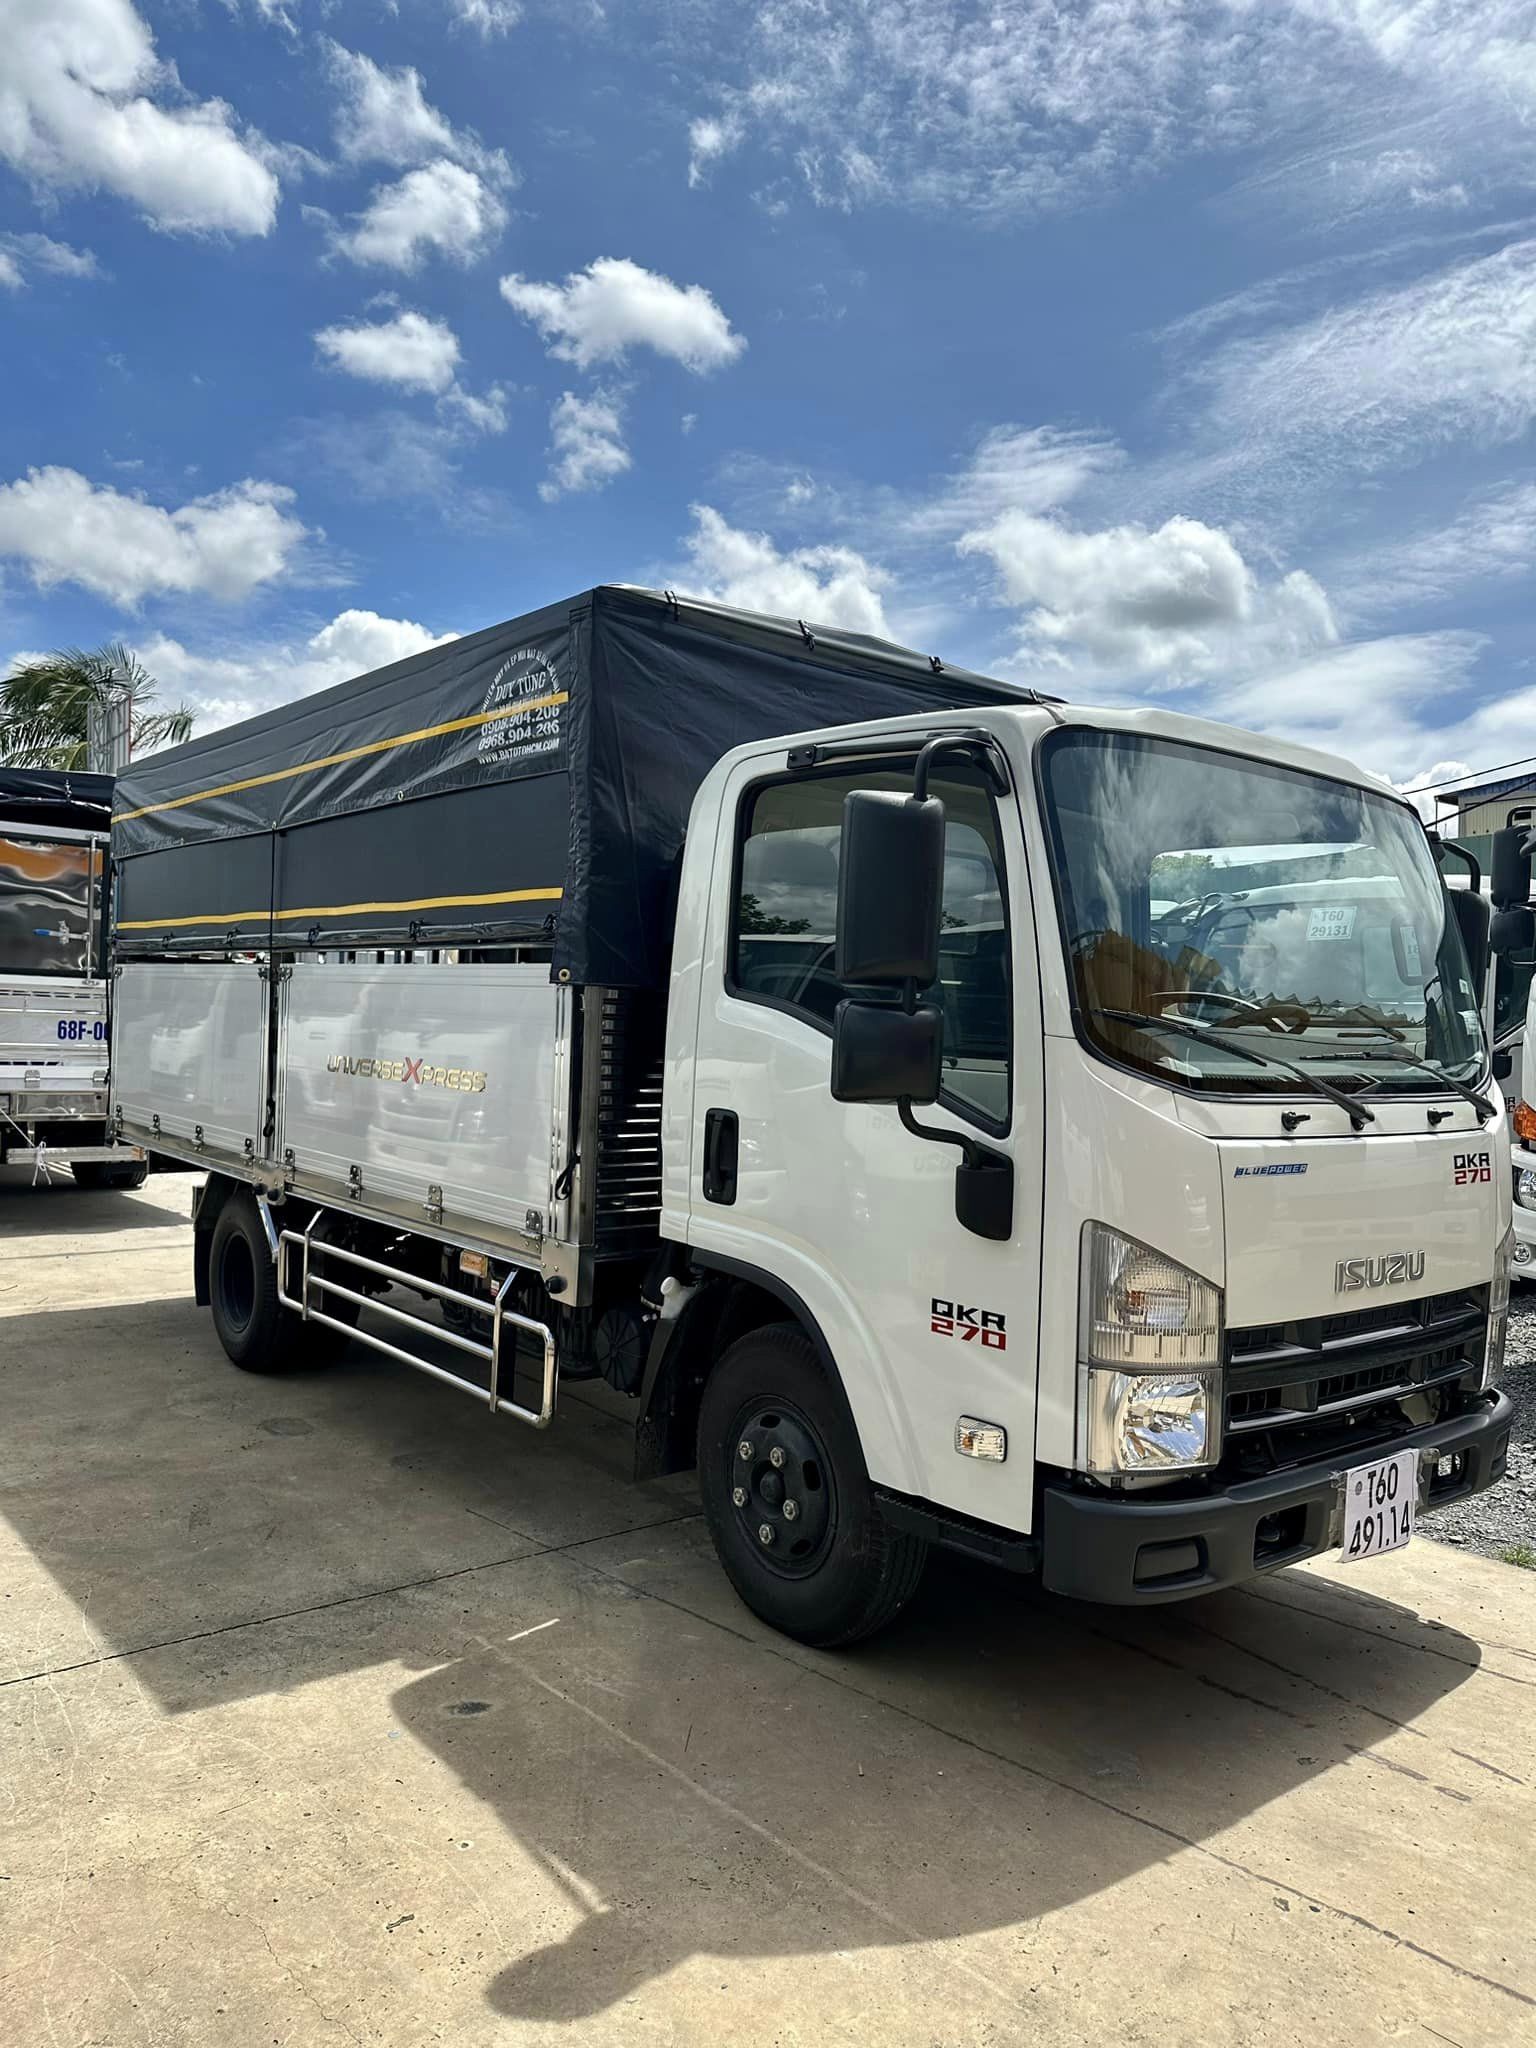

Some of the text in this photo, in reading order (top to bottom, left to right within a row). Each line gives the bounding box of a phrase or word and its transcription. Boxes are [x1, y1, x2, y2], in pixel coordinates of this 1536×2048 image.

[1454, 1152, 1490, 1169] QKR
[1455, 1168, 1491, 1186] 270
[1335, 1250, 1425, 1293] ISUZU
[931, 1297, 1006, 1332] QKR
[931, 1315, 1006, 1351] 270
[1368, 1463, 1398, 1508] T60
[1349, 1500, 1410, 1556] 491.14
